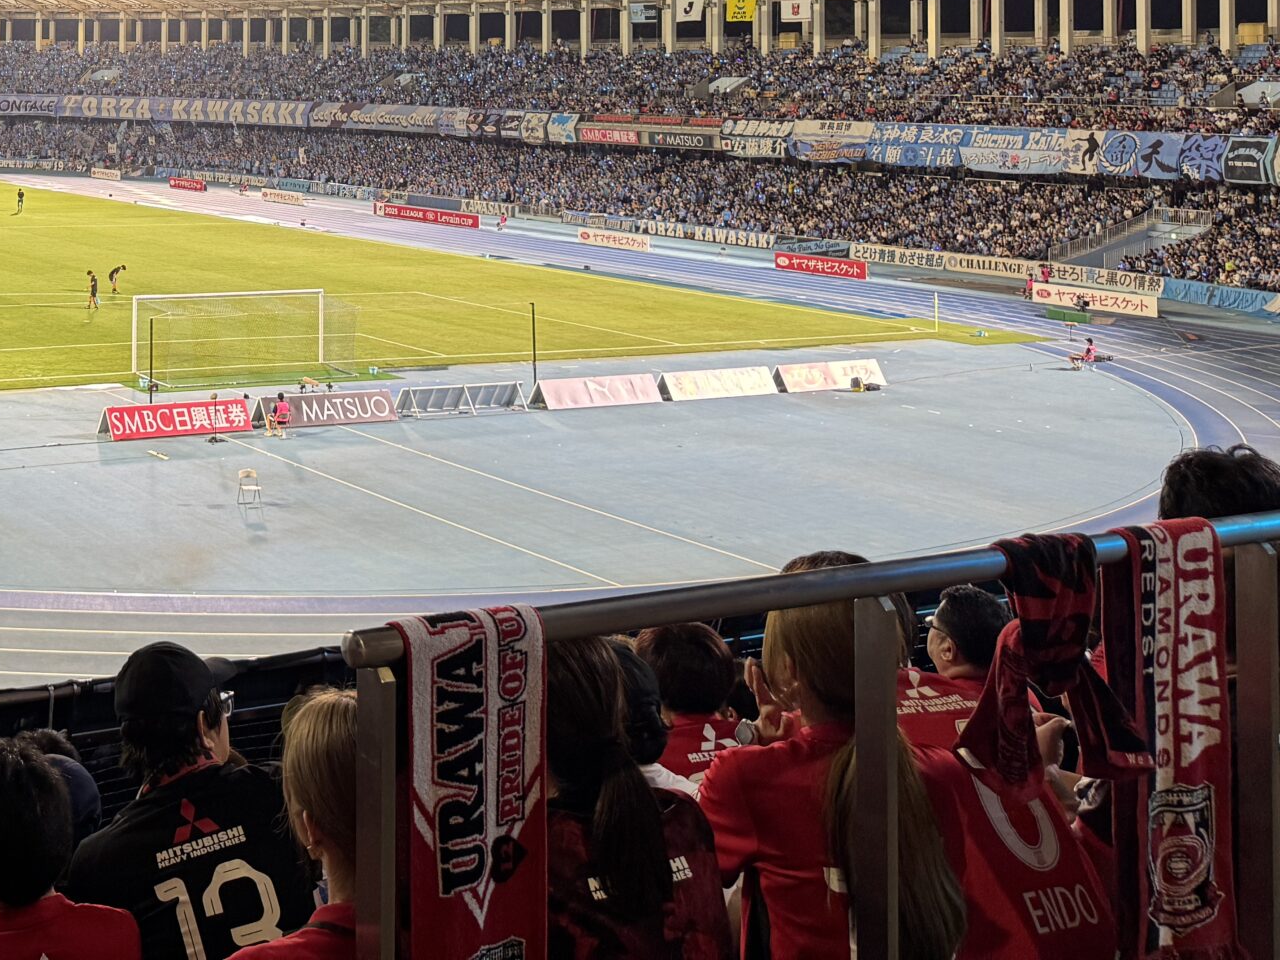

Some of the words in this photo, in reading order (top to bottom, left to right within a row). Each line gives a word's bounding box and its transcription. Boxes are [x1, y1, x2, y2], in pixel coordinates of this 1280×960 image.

[63, 95, 151, 119] FORZA
[172, 99, 306, 125] KAWASAKI
[582, 128, 638, 144] SMBC日興証券
[666, 135, 704, 147] MATSUO
[384, 206, 399, 215] 2025
[437, 212, 460, 224] Levain
[460, 217, 473, 226] CUP
[460, 199, 512, 216] KAWASAKI
[592, 233, 647, 248] ヤマザキビスケット
[638, 219, 685, 238] FORZA
[694, 225, 776, 249] KAWASAKI
[824, 241, 841, 250] Gain
[791, 256, 861, 277] ヤマザキビスケット
[853, 246, 896, 263] とどけ青援
[958, 257, 1024, 275] CHALLENGE
[111, 401, 249, 436] SMBC日興証券
[300, 395, 391, 422] MATSUO
[1149, 526, 1172, 769] DIAMONDS
[1179, 527, 1221, 768] URAWA
[498, 649, 528, 701] OF
[896, 706, 924, 715] EAVY
[900, 693, 964, 707] MITSUBISHI
[436, 639, 488, 897] URAWA
[498, 702, 527, 826] PRIDE
[156, 825, 245, 863] MITSUBISHI
[158, 853, 187, 869] HEAVY
[190, 834, 247, 859] INDUSTRIES
[1022, 884, 1099, 936] ENDO
